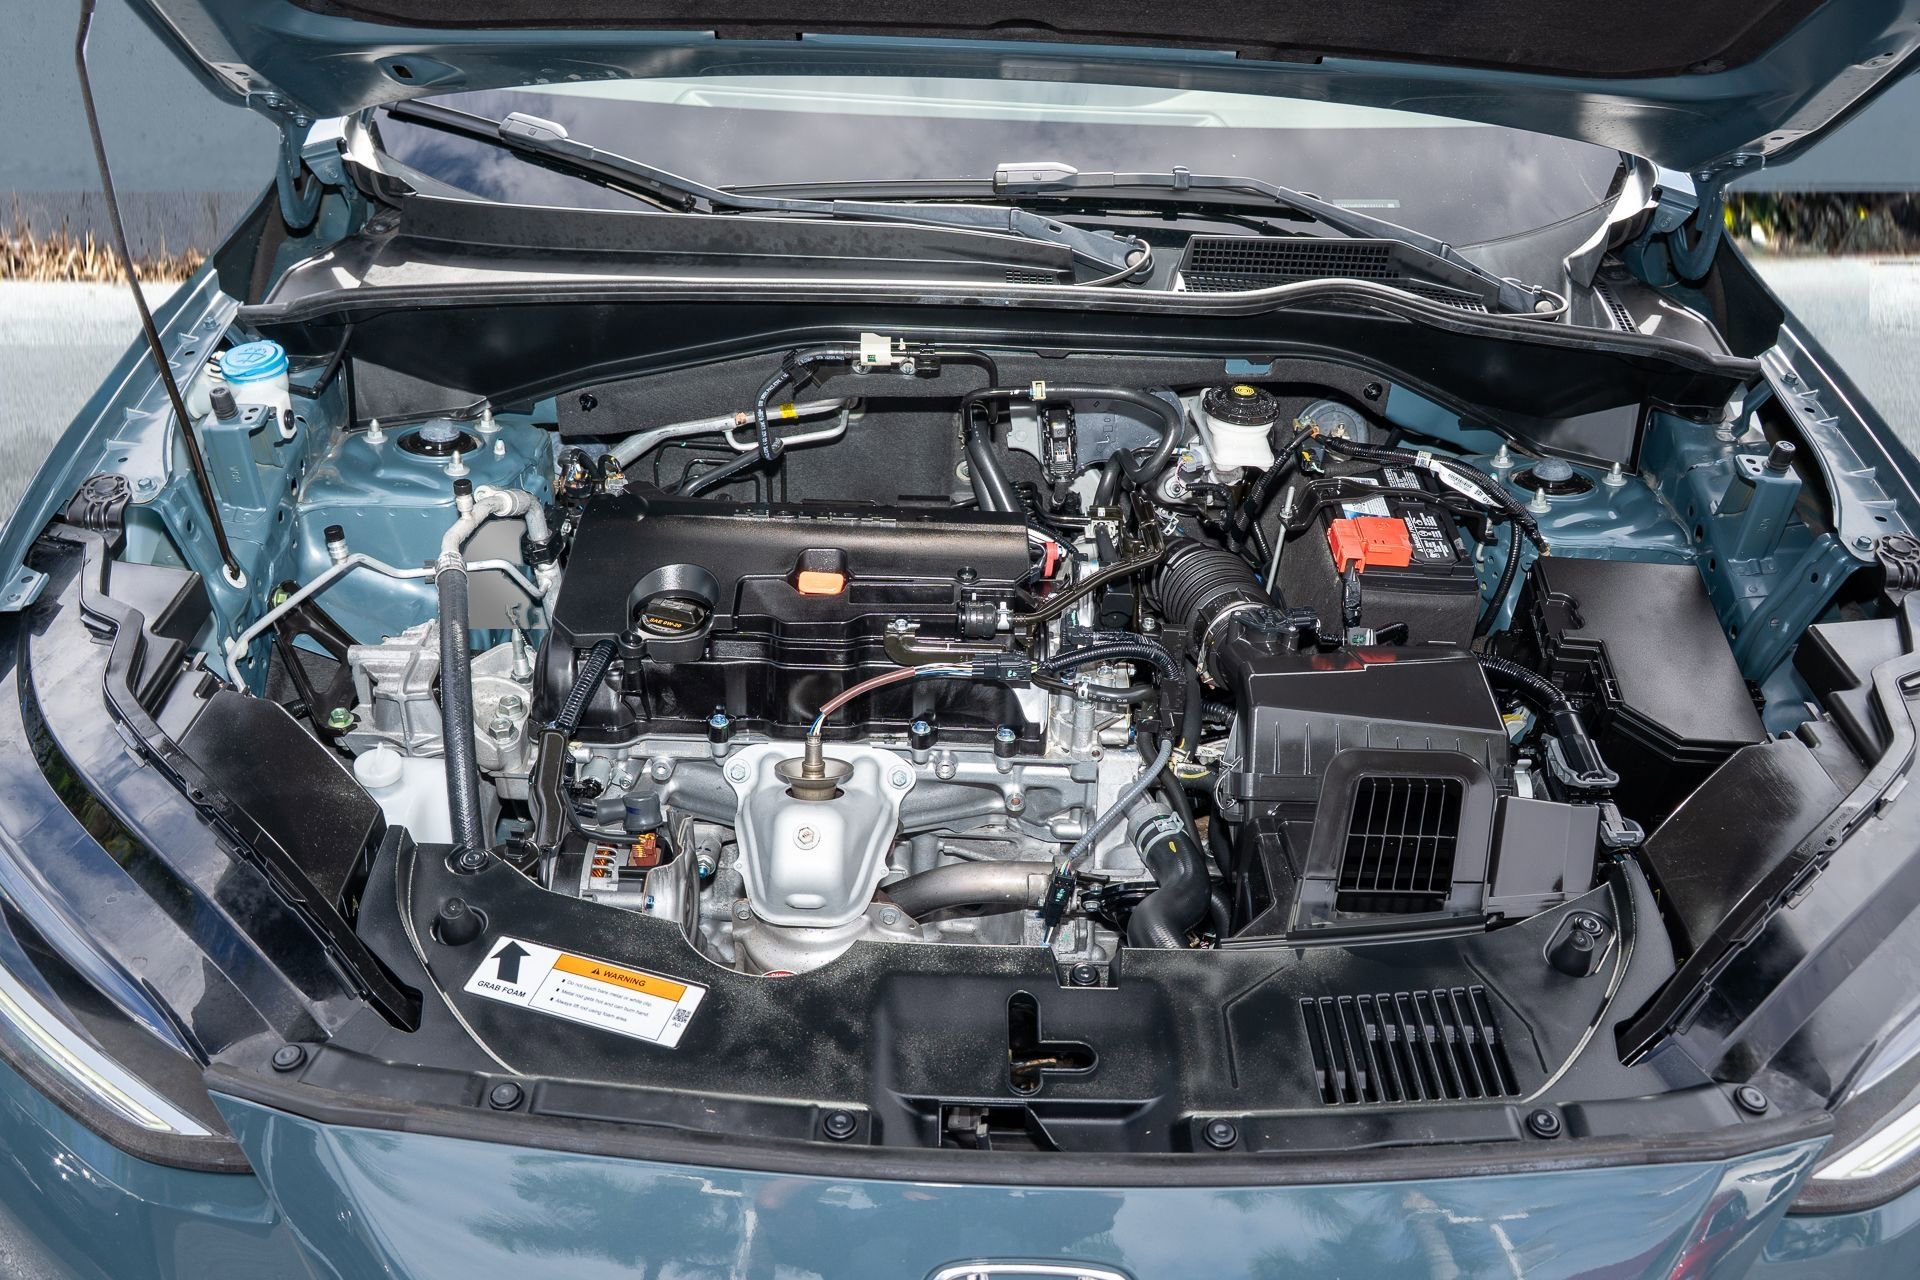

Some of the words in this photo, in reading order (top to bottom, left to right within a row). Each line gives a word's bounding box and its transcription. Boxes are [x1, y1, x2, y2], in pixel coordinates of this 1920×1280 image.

[650, 617, 663, 625] SAE
[663, 620, 682, 628] 0W-20
[603, 970, 646, 987] WARNING
[477, 980, 501, 991] GRAB
[501, 986, 526, 998] FOAM
